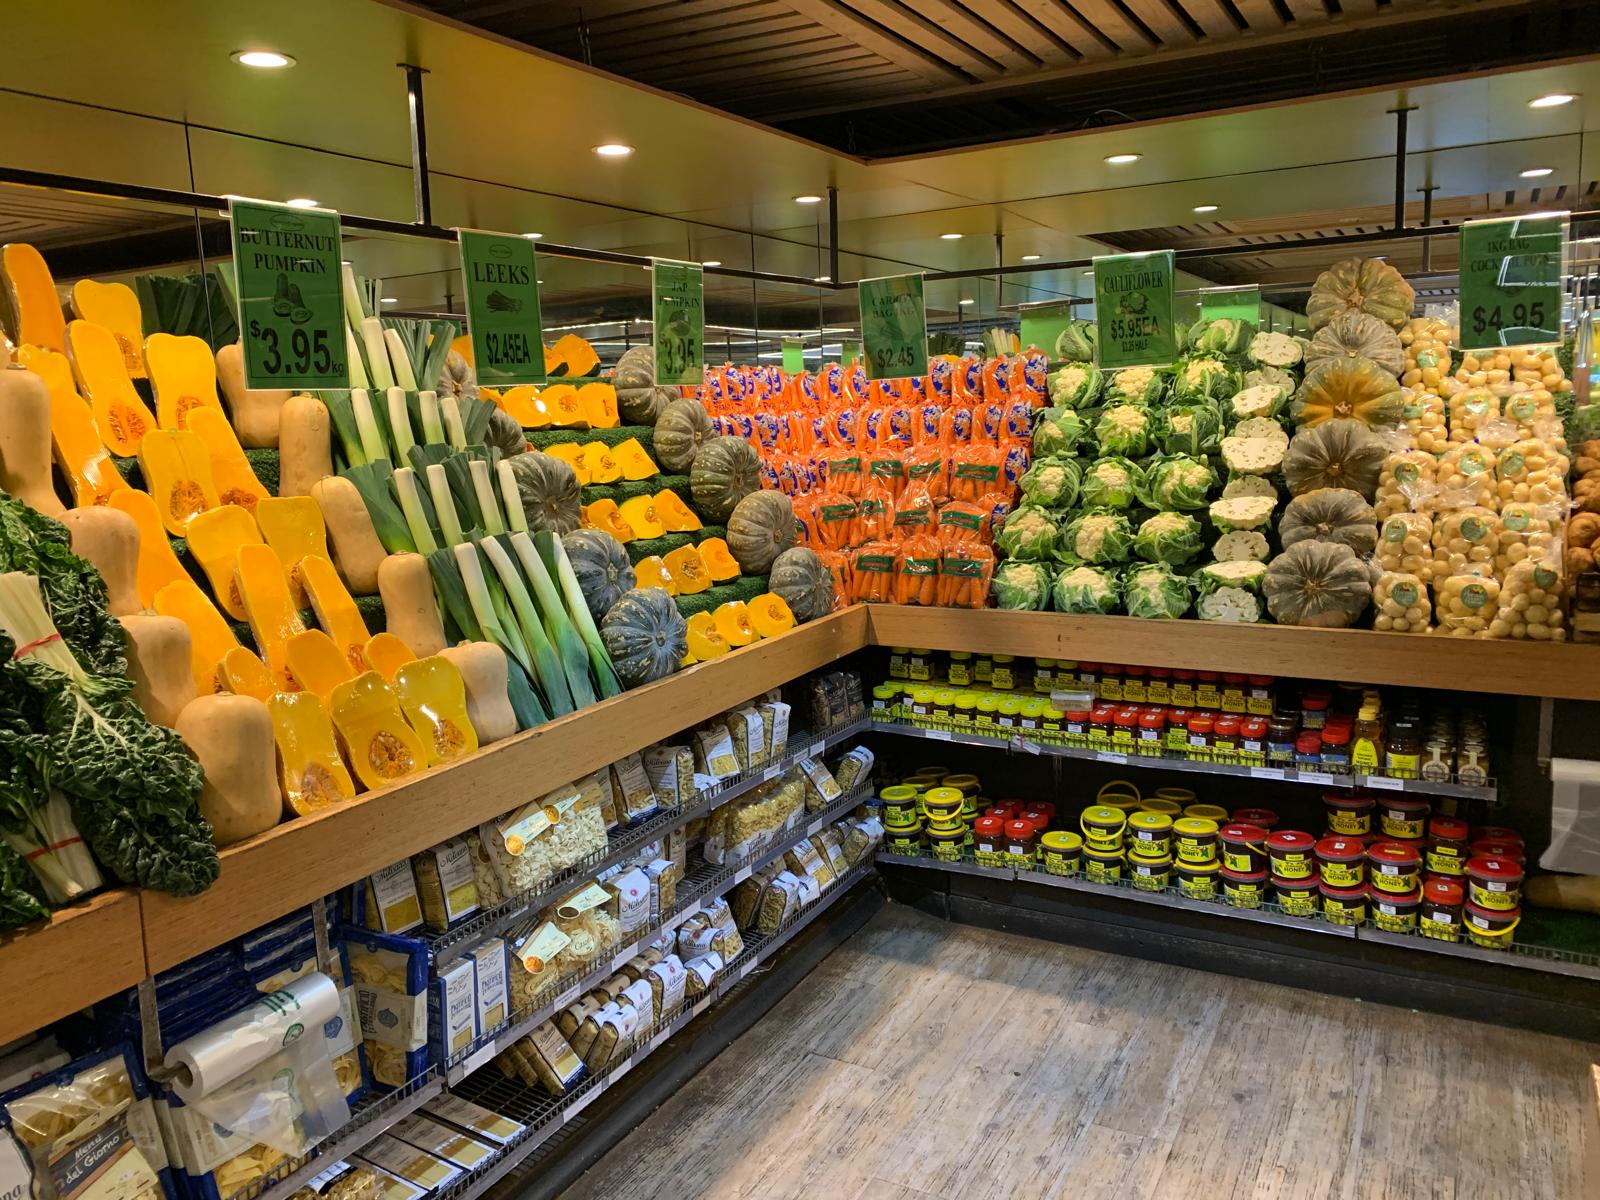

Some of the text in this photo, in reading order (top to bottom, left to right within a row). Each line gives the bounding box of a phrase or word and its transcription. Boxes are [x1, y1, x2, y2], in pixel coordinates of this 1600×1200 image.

[239, 227, 335, 252] BUTTERNUT
[254, 253, 326, 274] PUMPKIN
[473, 262, 530, 286] LEEKS
[1103, 271, 1164, 294] CAULIFLOWER
[658, 296, 700, 308] PUMPKIN
[1472, 302, 1545, 337] $4.95
[877, 346, 915, 369] $2.45
[65, 1135, 120, 1184] del Giorno
